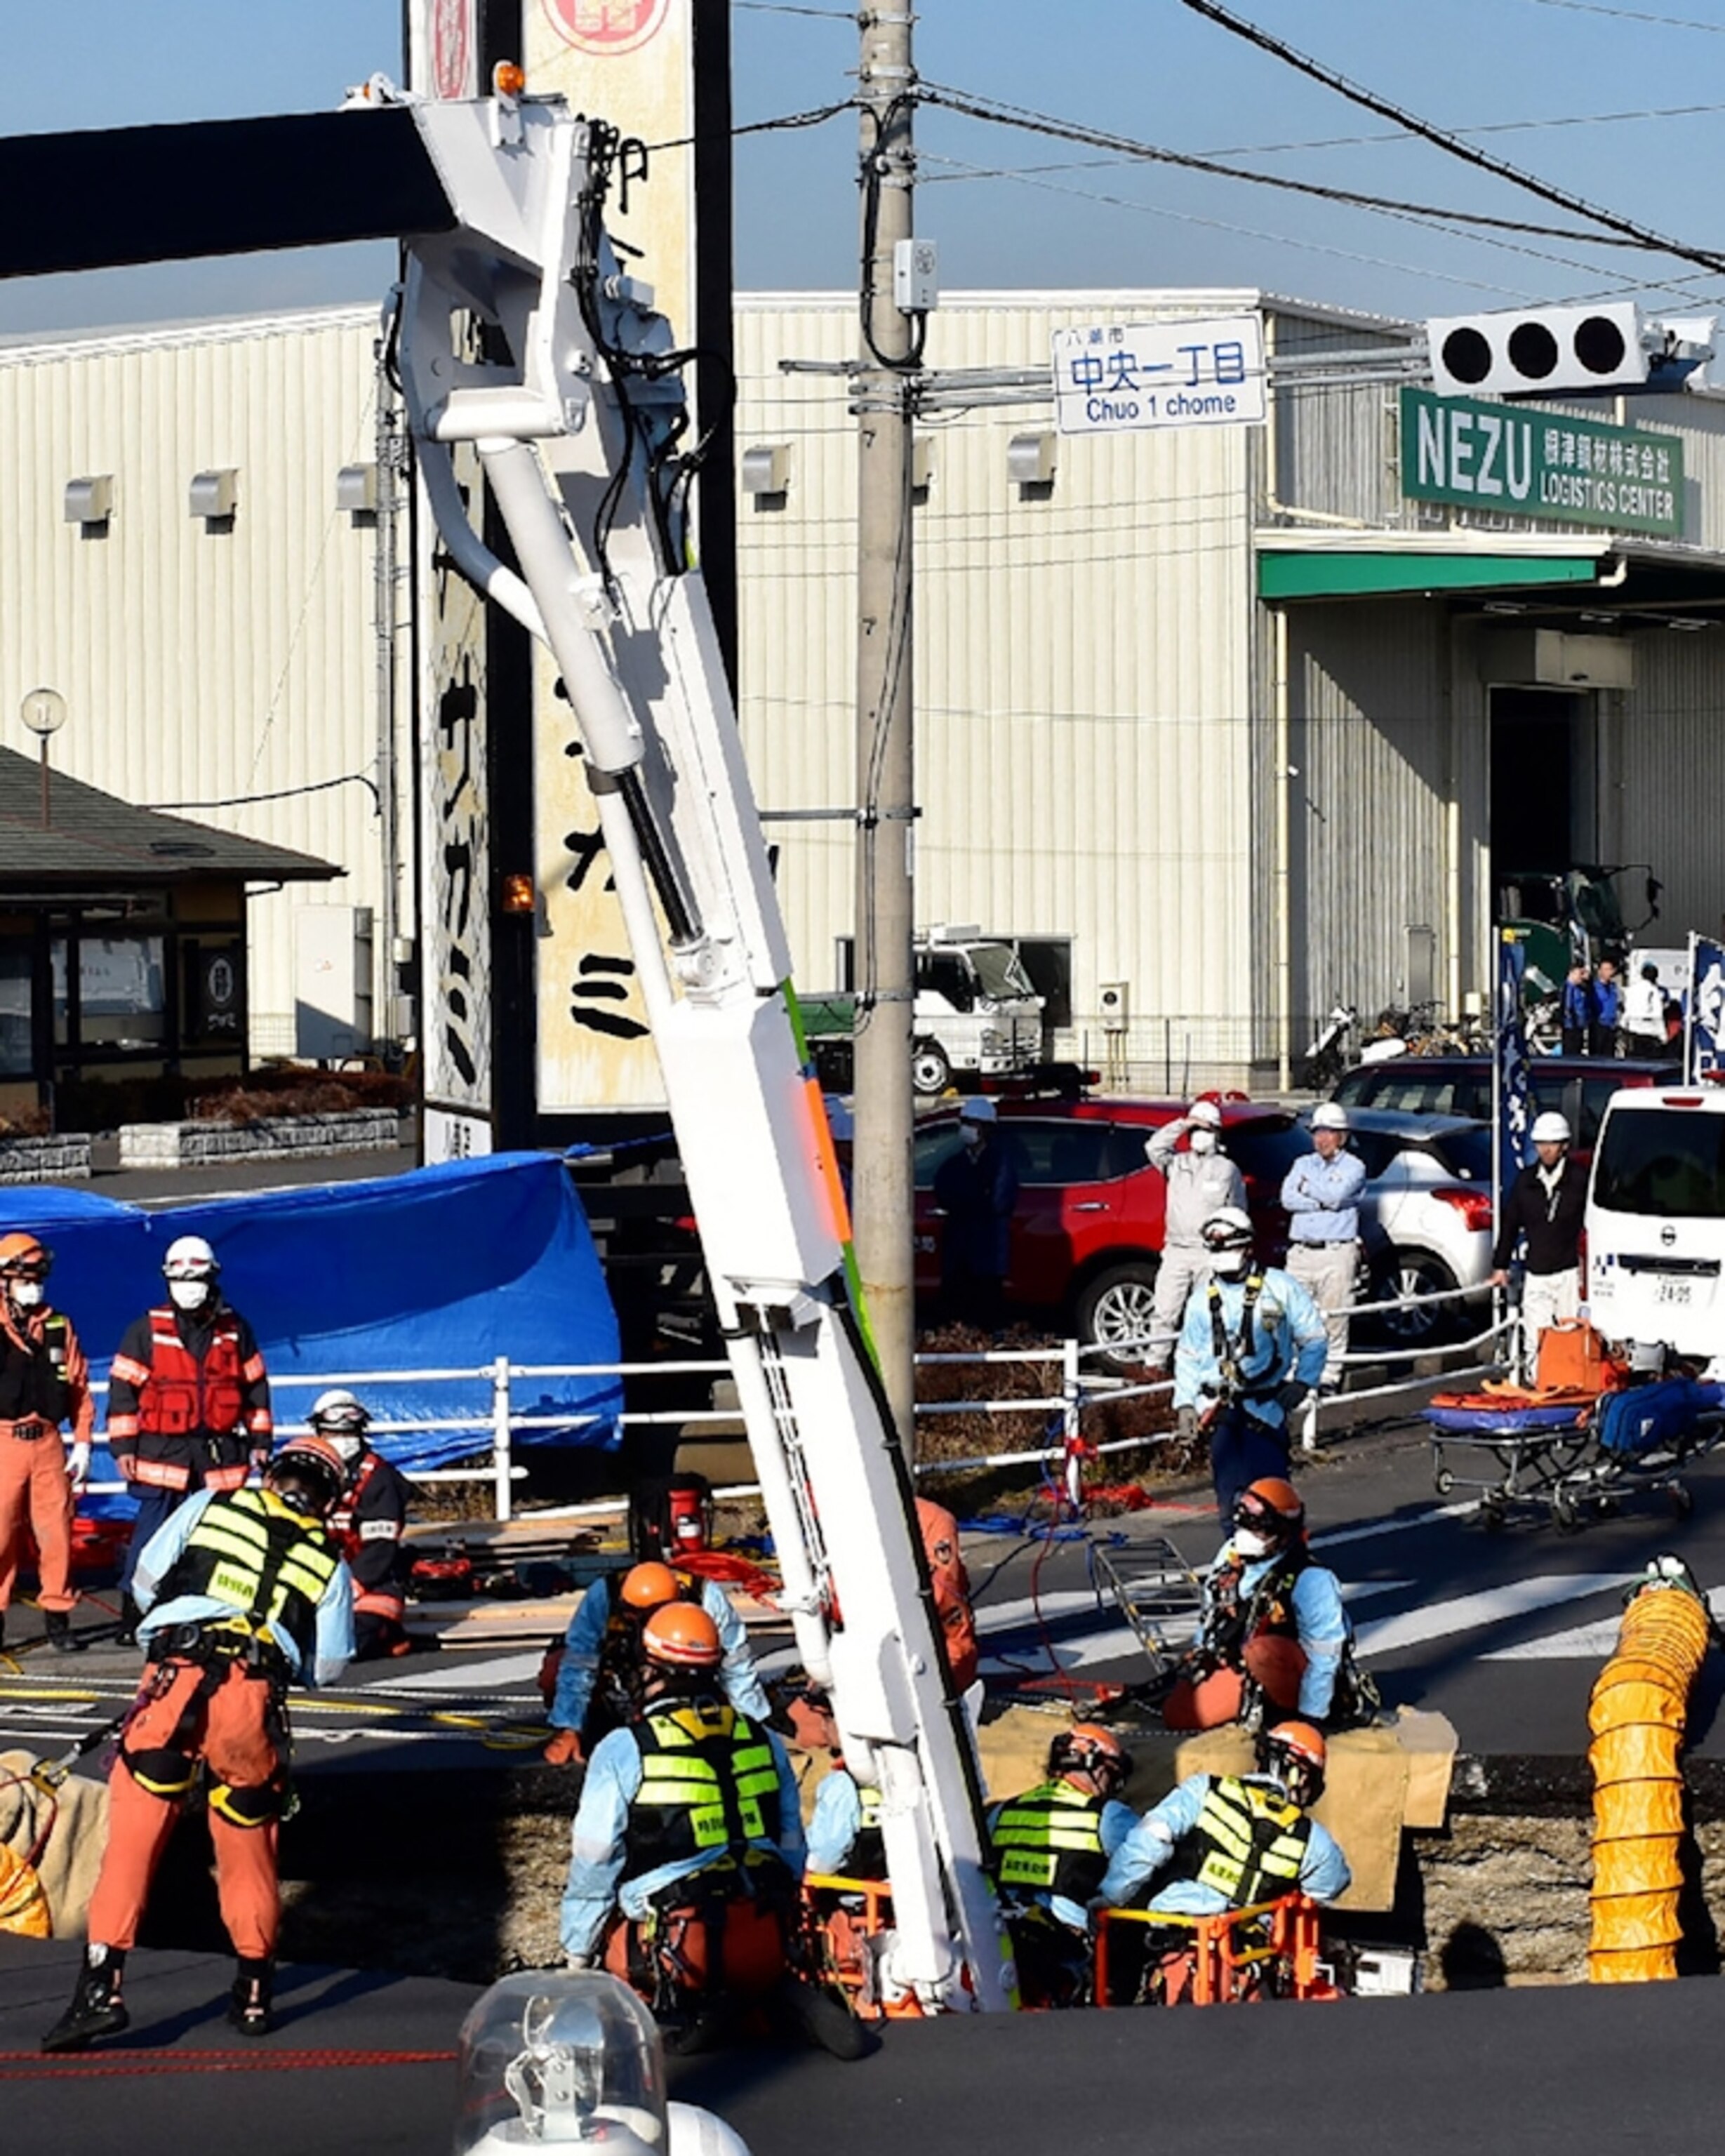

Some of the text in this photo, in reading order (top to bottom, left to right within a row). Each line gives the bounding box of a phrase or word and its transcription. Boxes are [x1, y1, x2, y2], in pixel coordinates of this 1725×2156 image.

[1071, 342, 1245, 396] 中央一丁目
[1086, 393, 1236, 422] Chuo 1 chome
[1418, 404, 1531, 500] NEZU
[1540, 470, 1674, 521] LOGISTICS CENTER
